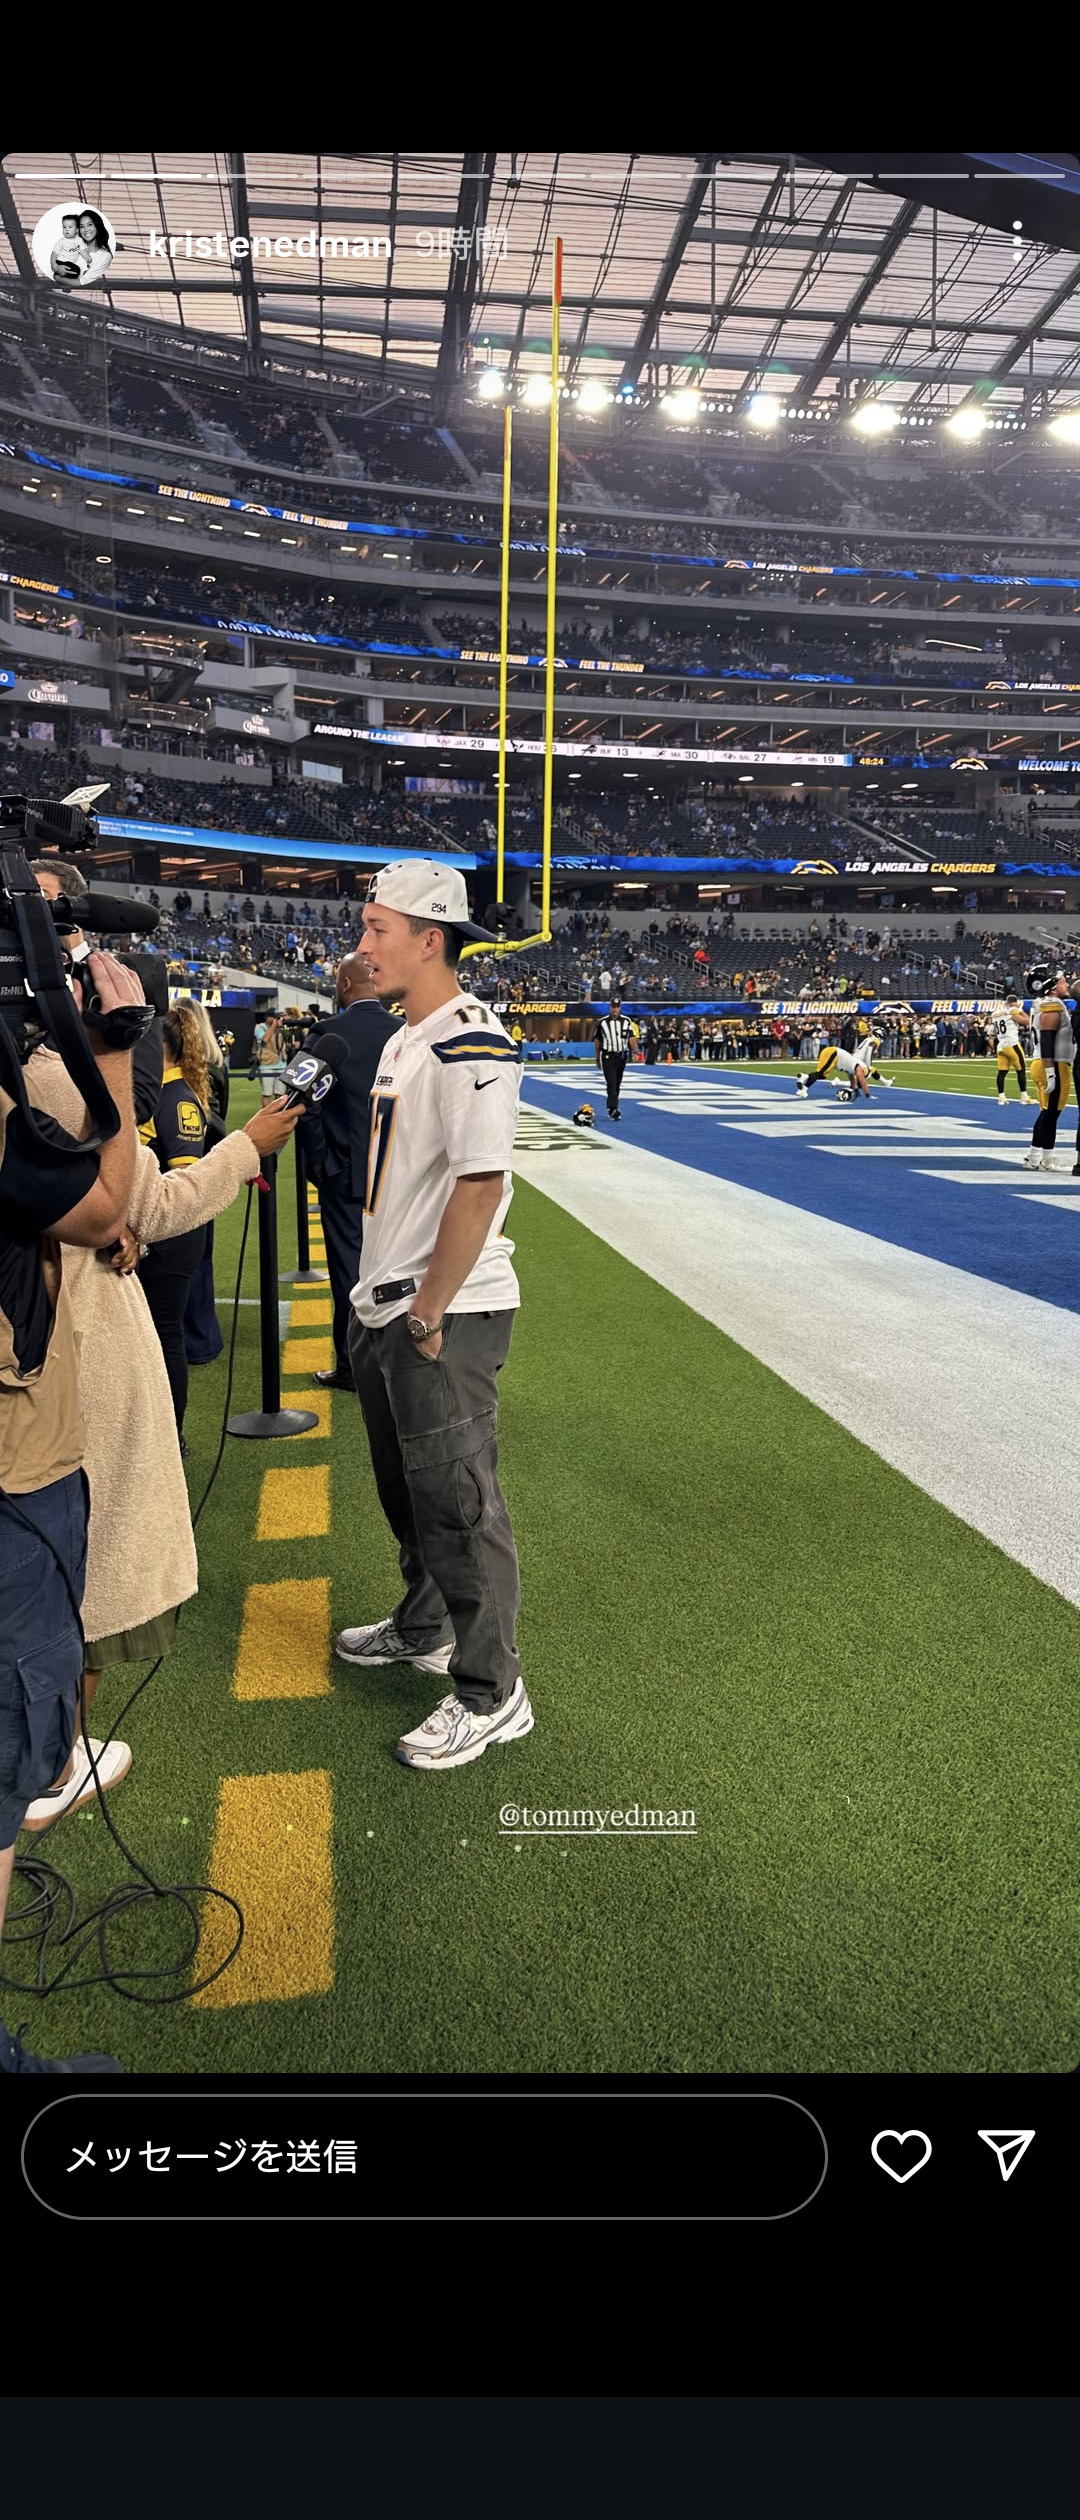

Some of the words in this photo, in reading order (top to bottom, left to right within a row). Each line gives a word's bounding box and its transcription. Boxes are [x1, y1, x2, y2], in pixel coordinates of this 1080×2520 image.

[158, 485, 173, 496] SEE
[174, 487, 188, 499] THE
[189, 491, 231, 508] LIGHTNING
[282, 510, 299, 521] FEEL
[300, 514, 313, 525] THE
[314, 517, 349, 530] THUNDER
[767, 563, 798, 571] ANGELES
[798, 565, 833, 573] CHARGERS
[10, 575, 60, 594] CHARGERS
[460, 650, 475, 660] SEE
[475, 651, 489, 661] THE
[489, 653, 529, 665] LIGTNING
[579, 660, 595, 669] FEEL
[596, 661, 610, 670] THE
[611, 662, 645, 673] THUNDER
[313, 724, 352, 737] AROUND
[352, 729, 370, 740] THE
[370, 731, 405, 743] LEAGUE
[470, 739, 485, 748] 29
[617, 748, 629, 757] 13
[684, 751, 699, 760] 30
[753, 753, 768, 762] 27
[823, 756, 835, 764] 19
[859, 757, 884, 766] 48:24
[1018, 760, 1069, 771] WELCOME
[845, 862, 871, 872] LOS
[871, 862, 929, 875] ANGELES
[930, 863, 996, 875] CHARGERS
[431, 902, 447, 913] 294
[509, 1003, 567, 1015] CHARGERS
[760, 1002, 779, 1014] SEE
[781, 1002, 801, 1014] THE
[802, 1002, 859, 1014] LIGHTNING
[931, 1001, 954, 1012] FEEL
[956, 1001, 976, 1012] THE
[453, 1004, 489, 1025] 17
[292, 1058, 319, 1085] 7
